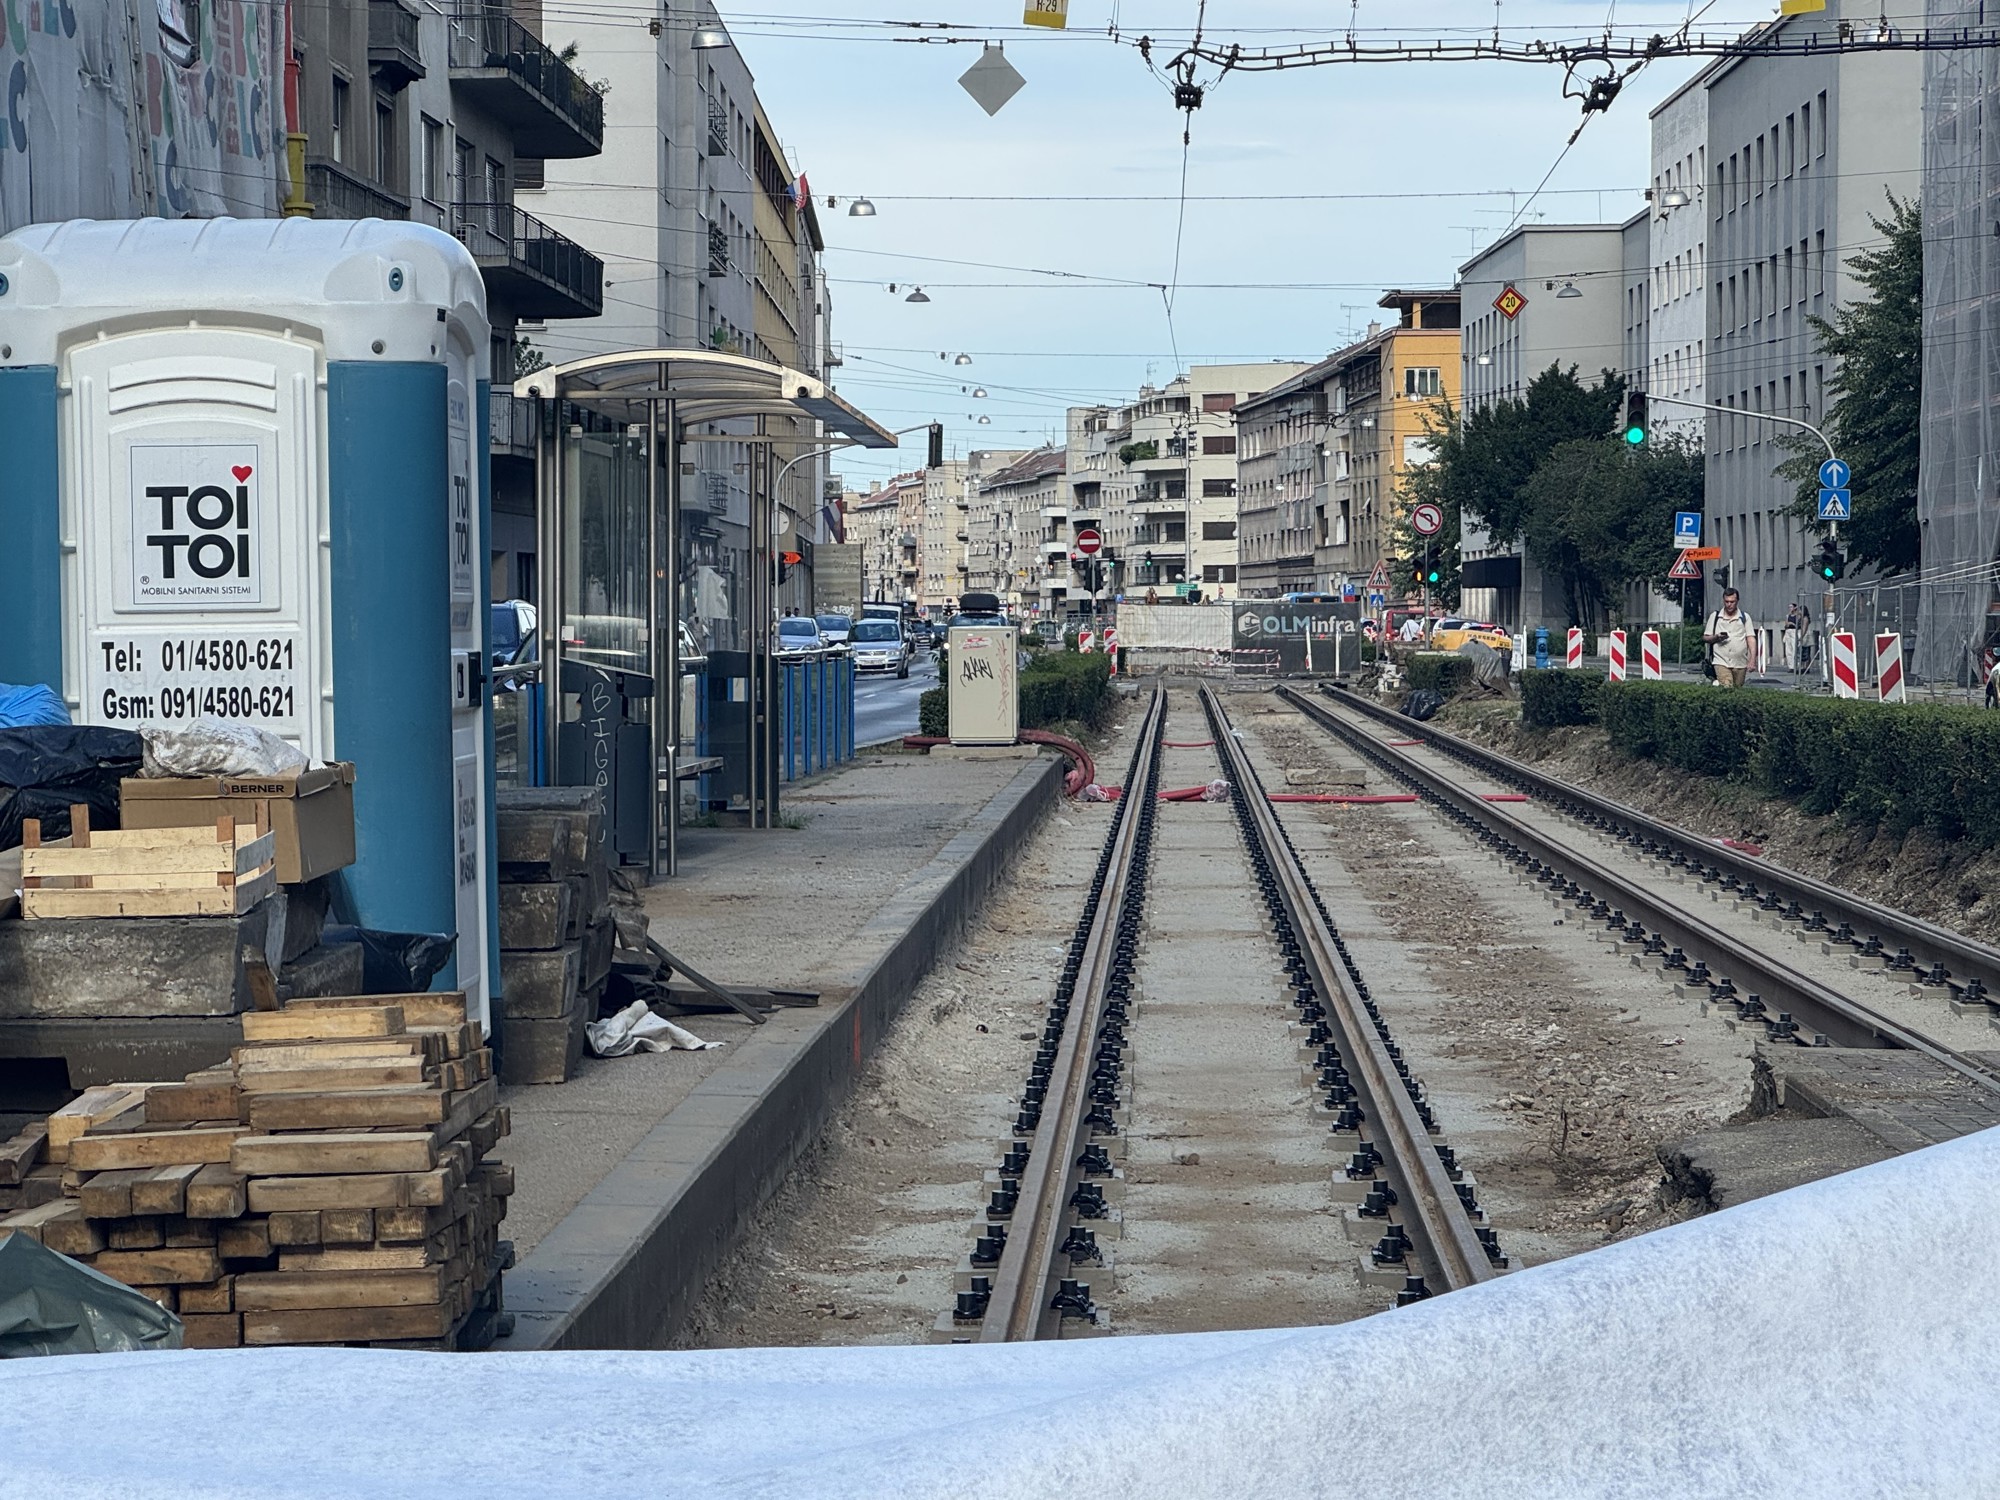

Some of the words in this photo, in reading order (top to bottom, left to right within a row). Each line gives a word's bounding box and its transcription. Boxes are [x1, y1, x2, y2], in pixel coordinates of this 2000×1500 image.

[1505, 296, 1516, 308] 20
[454, 475, 469, 519] TOI
[1682, 517, 1694, 532] P
[147, 534, 250, 579] TOI
[455, 522, 469, 565] TOI
[141, 587, 176, 596] MOBILNI
[178, 586, 220, 595] SANITARNI
[221, 586, 251, 595] SISTEMI
[101, 641, 142, 673] Tel:
[161, 639, 293, 672] 01/4580-621
[102, 688, 154, 720] Gsm:
[160, 685, 294, 719] 091/4580-621
[231, 784, 285, 794] BERNER
